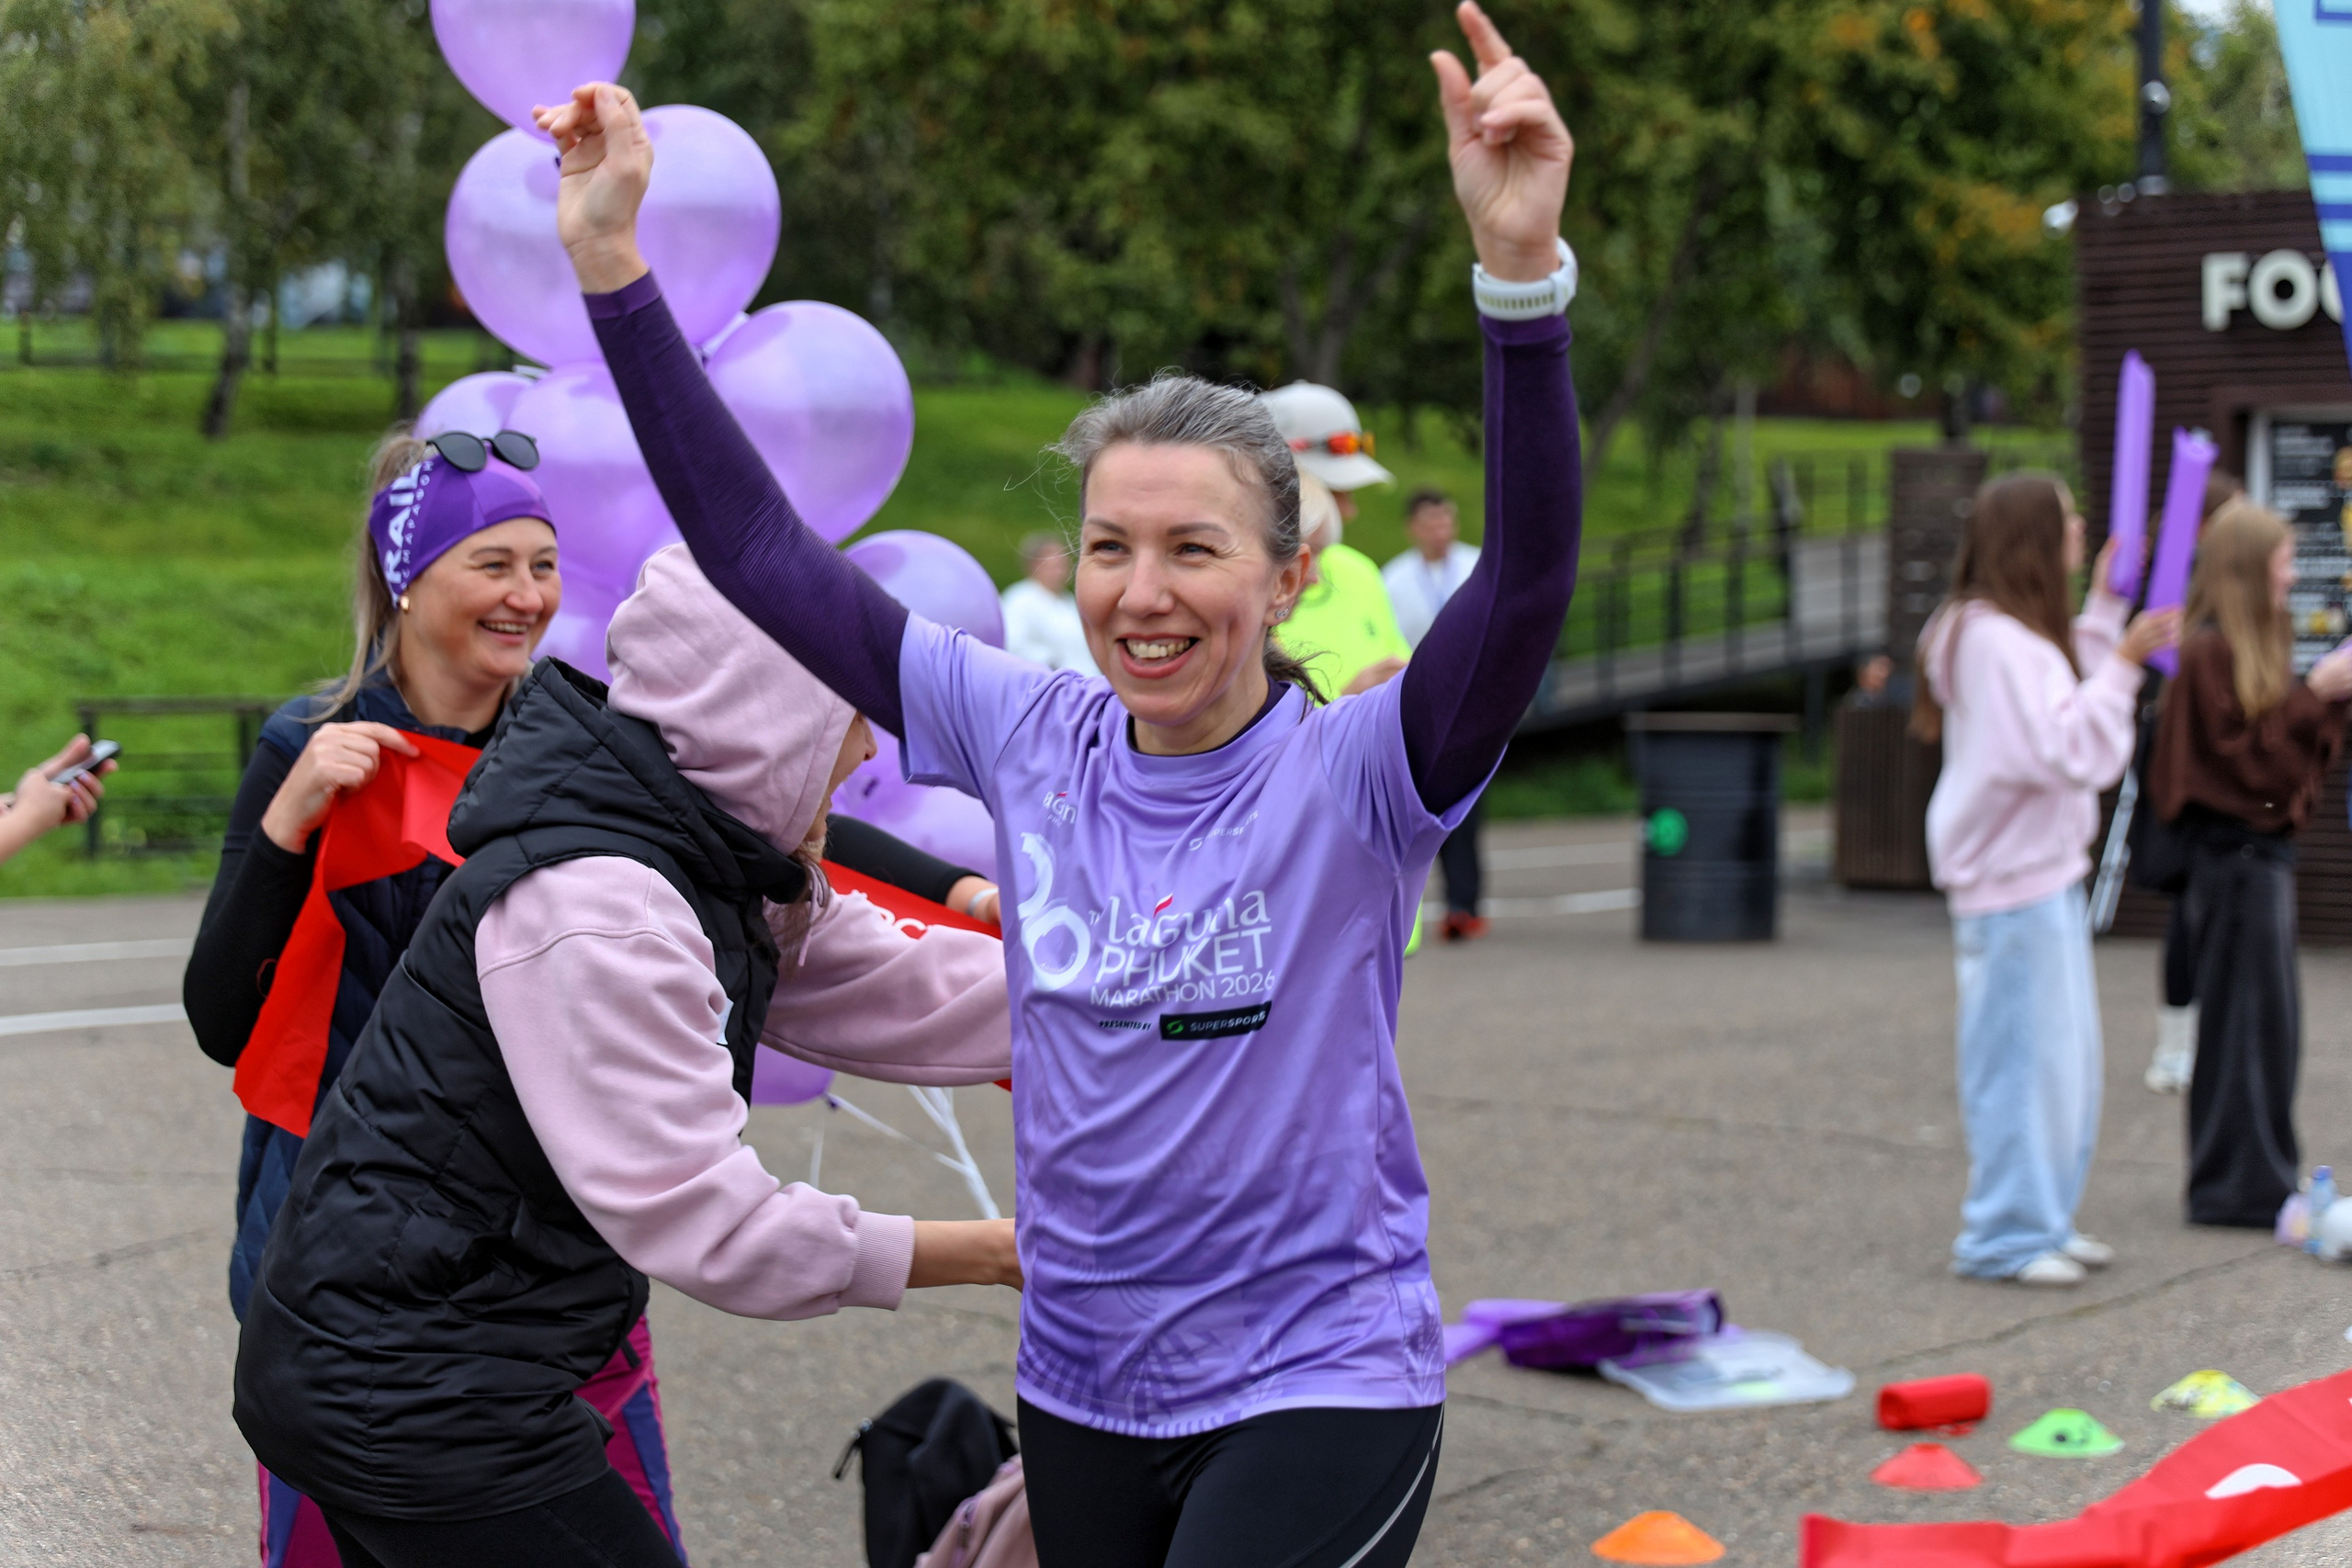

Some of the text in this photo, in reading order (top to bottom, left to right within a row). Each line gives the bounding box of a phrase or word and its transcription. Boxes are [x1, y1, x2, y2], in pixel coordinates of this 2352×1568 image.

[1094, 926, 1272, 987] PHUKET
[1091, 970, 1276, 1009] MARATHON 2026
